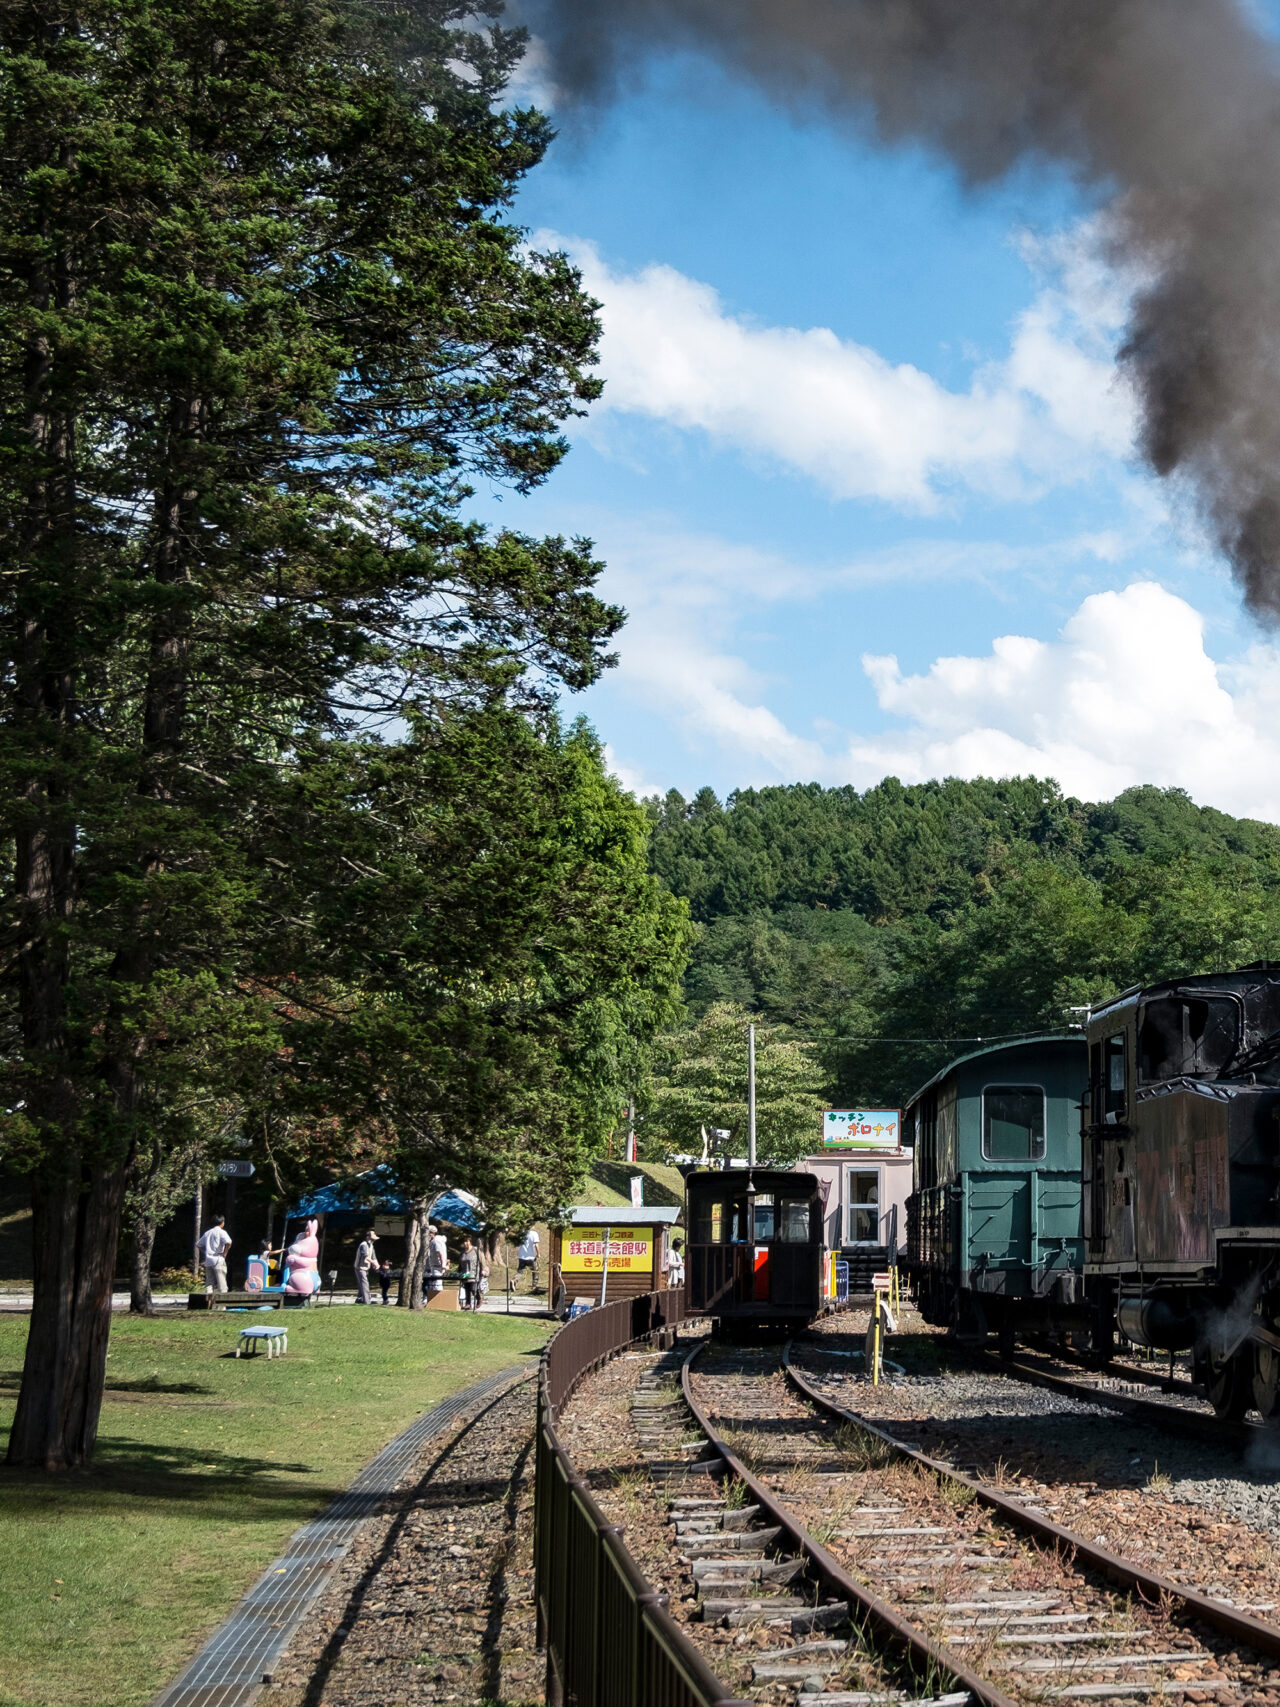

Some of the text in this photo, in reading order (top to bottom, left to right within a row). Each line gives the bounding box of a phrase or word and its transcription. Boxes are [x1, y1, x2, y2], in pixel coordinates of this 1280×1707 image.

[828, 1113, 865, 1122] キッチン
[582, 1231, 634, 1239] 三笠トッコ鉄道
[570, 1242, 647, 1255] 鉄道記念館駅
